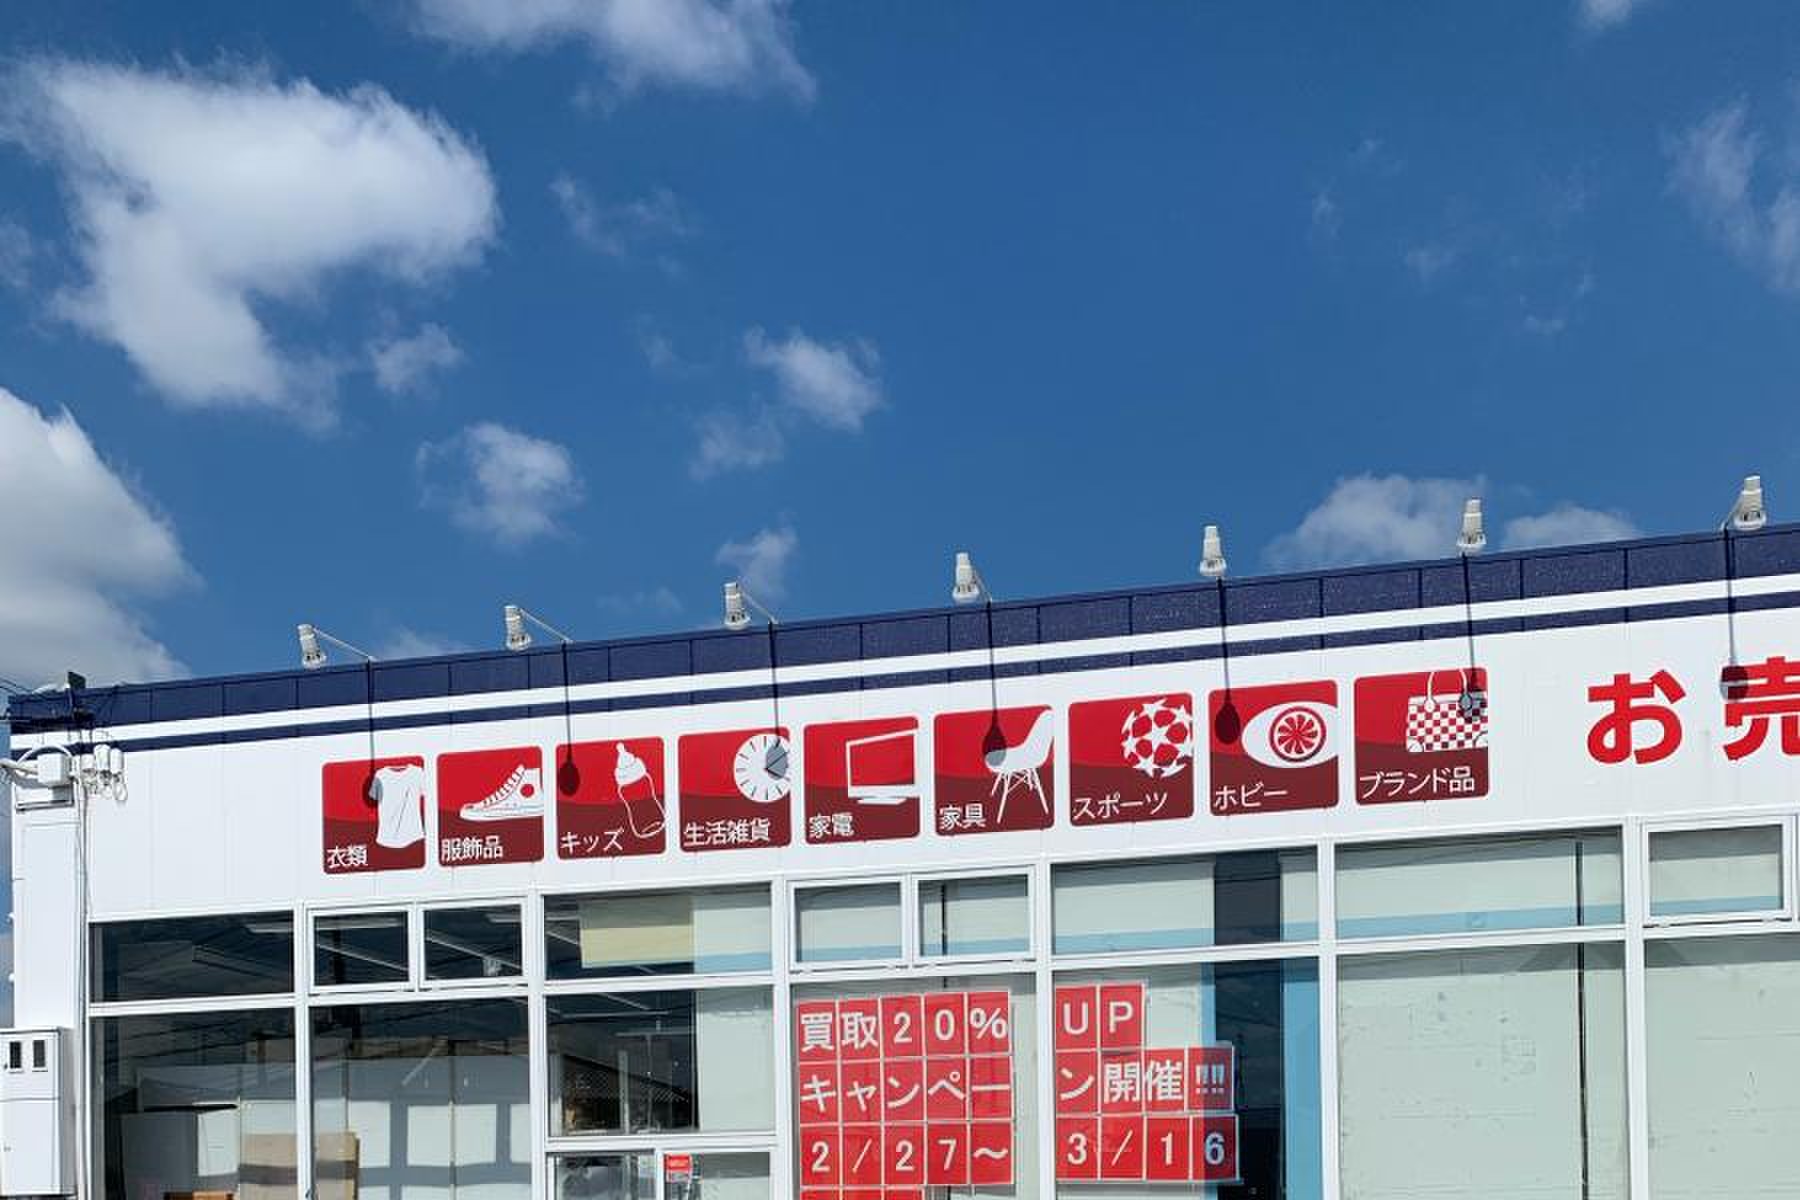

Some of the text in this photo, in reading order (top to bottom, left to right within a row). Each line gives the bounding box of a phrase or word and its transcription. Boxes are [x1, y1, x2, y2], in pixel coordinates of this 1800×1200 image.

[1214, 782, 1289, 811] ホビー
[1359, 766, 1476, 799] ブランド品
[938, 804, 987, 831] 家具
[1072, 793, 1168, 822] スポーツ
[683, 817, 771, 846] 生活雑貨
[808, 814, 855, 838] 家電
[440, 836, 504, 862] 服飾品
[559, 828, 625, 854] キッズ
[326, 846, 369, 867] 衣類
[1062, 1001, 1133, 1035] UP
[801, 1070, 1011, 1112] キャンペー
[1066, 1129, 1226, 1168] 3/16
